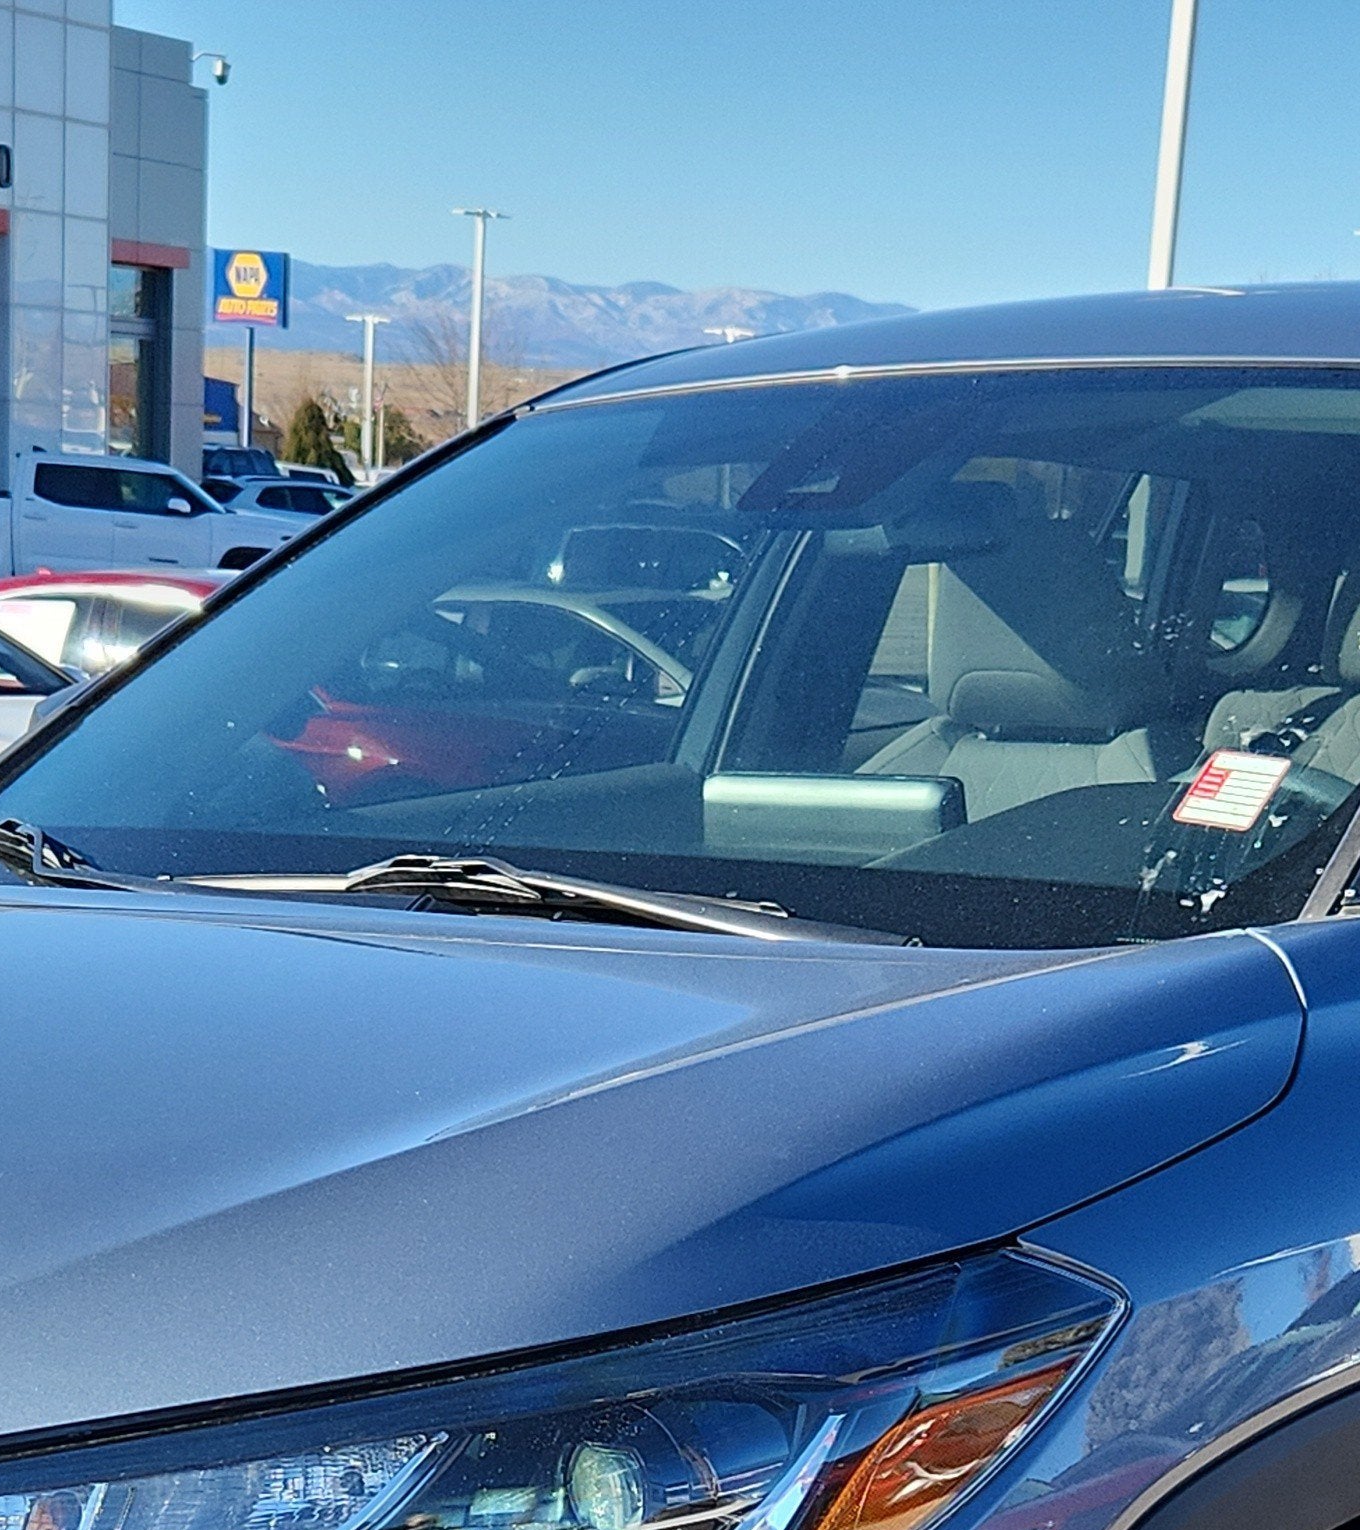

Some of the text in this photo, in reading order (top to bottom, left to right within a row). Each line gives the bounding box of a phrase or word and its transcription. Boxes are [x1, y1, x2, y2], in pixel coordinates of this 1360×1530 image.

[234, 265, 262, 285] NAPA
[217, 297, 278, 317] AUTO PARTS
